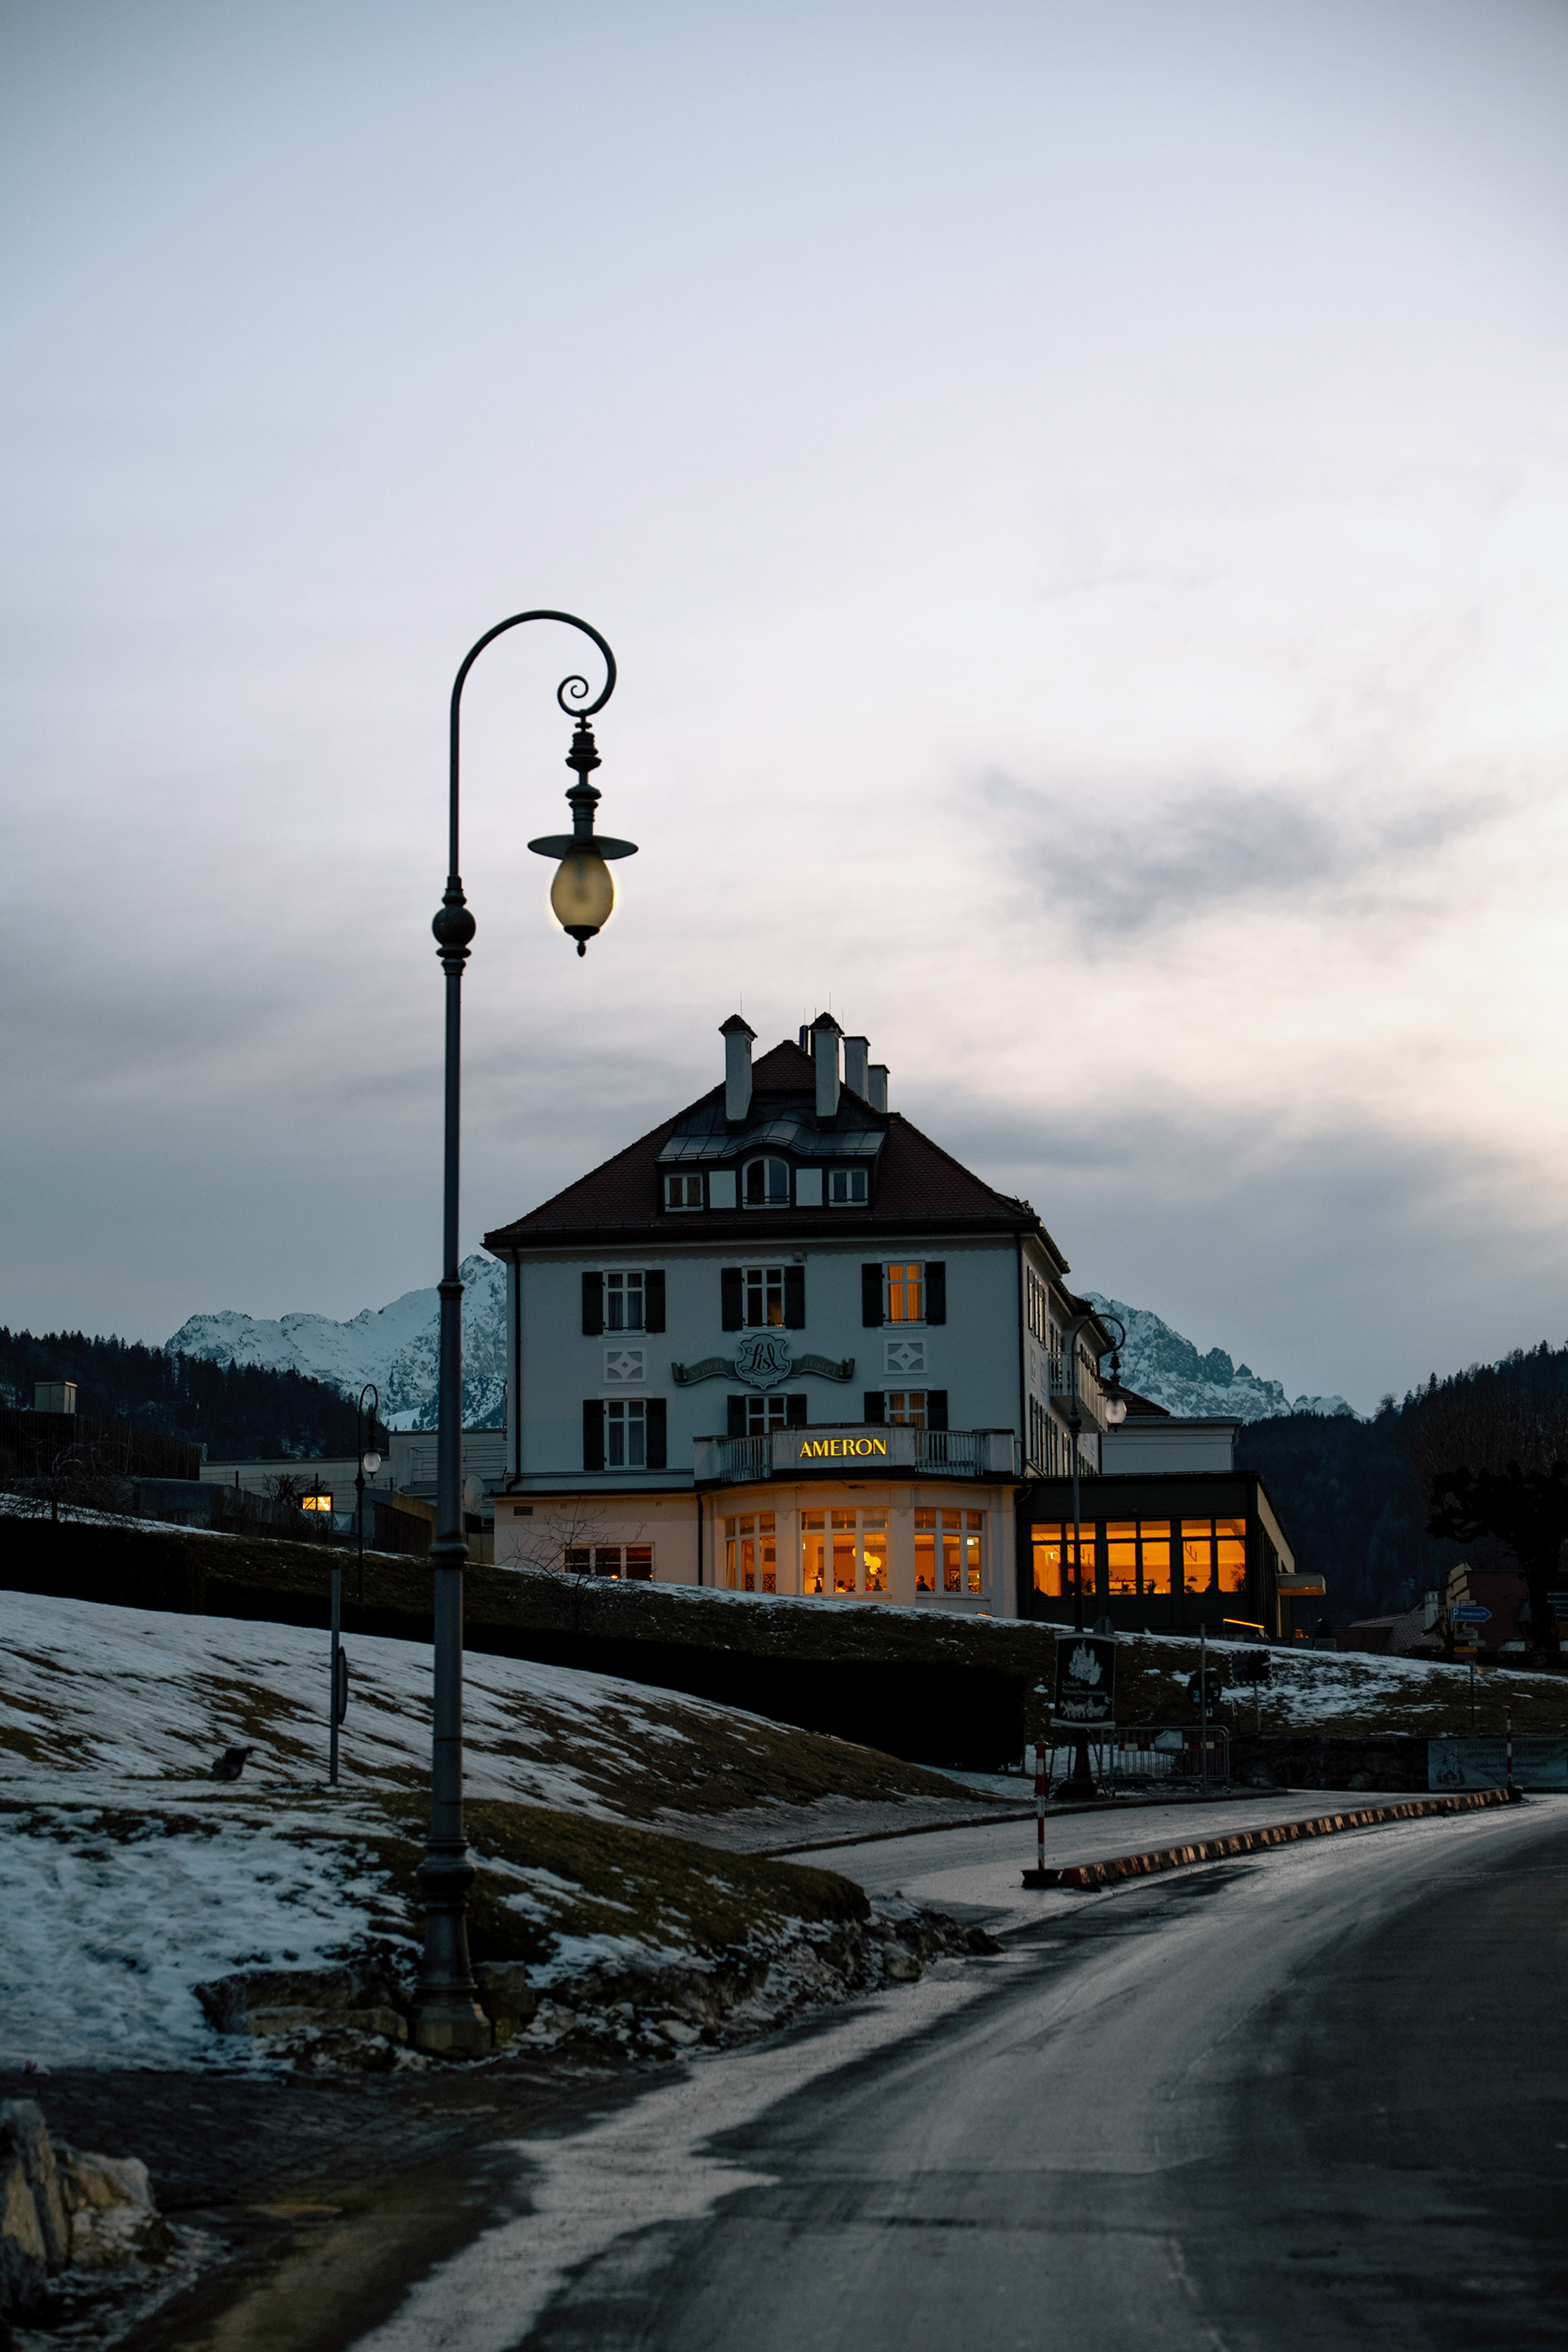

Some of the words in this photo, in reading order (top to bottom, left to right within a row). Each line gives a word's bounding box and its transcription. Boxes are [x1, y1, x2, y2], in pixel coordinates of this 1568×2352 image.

[743, 1343, 782, 1373] Lisl
[800, 1438, 887, 1458] AMERON
[1453, 1608, 1459, 1619] P
[1062, 1687, 1107, 1696] Neuschwanstein
